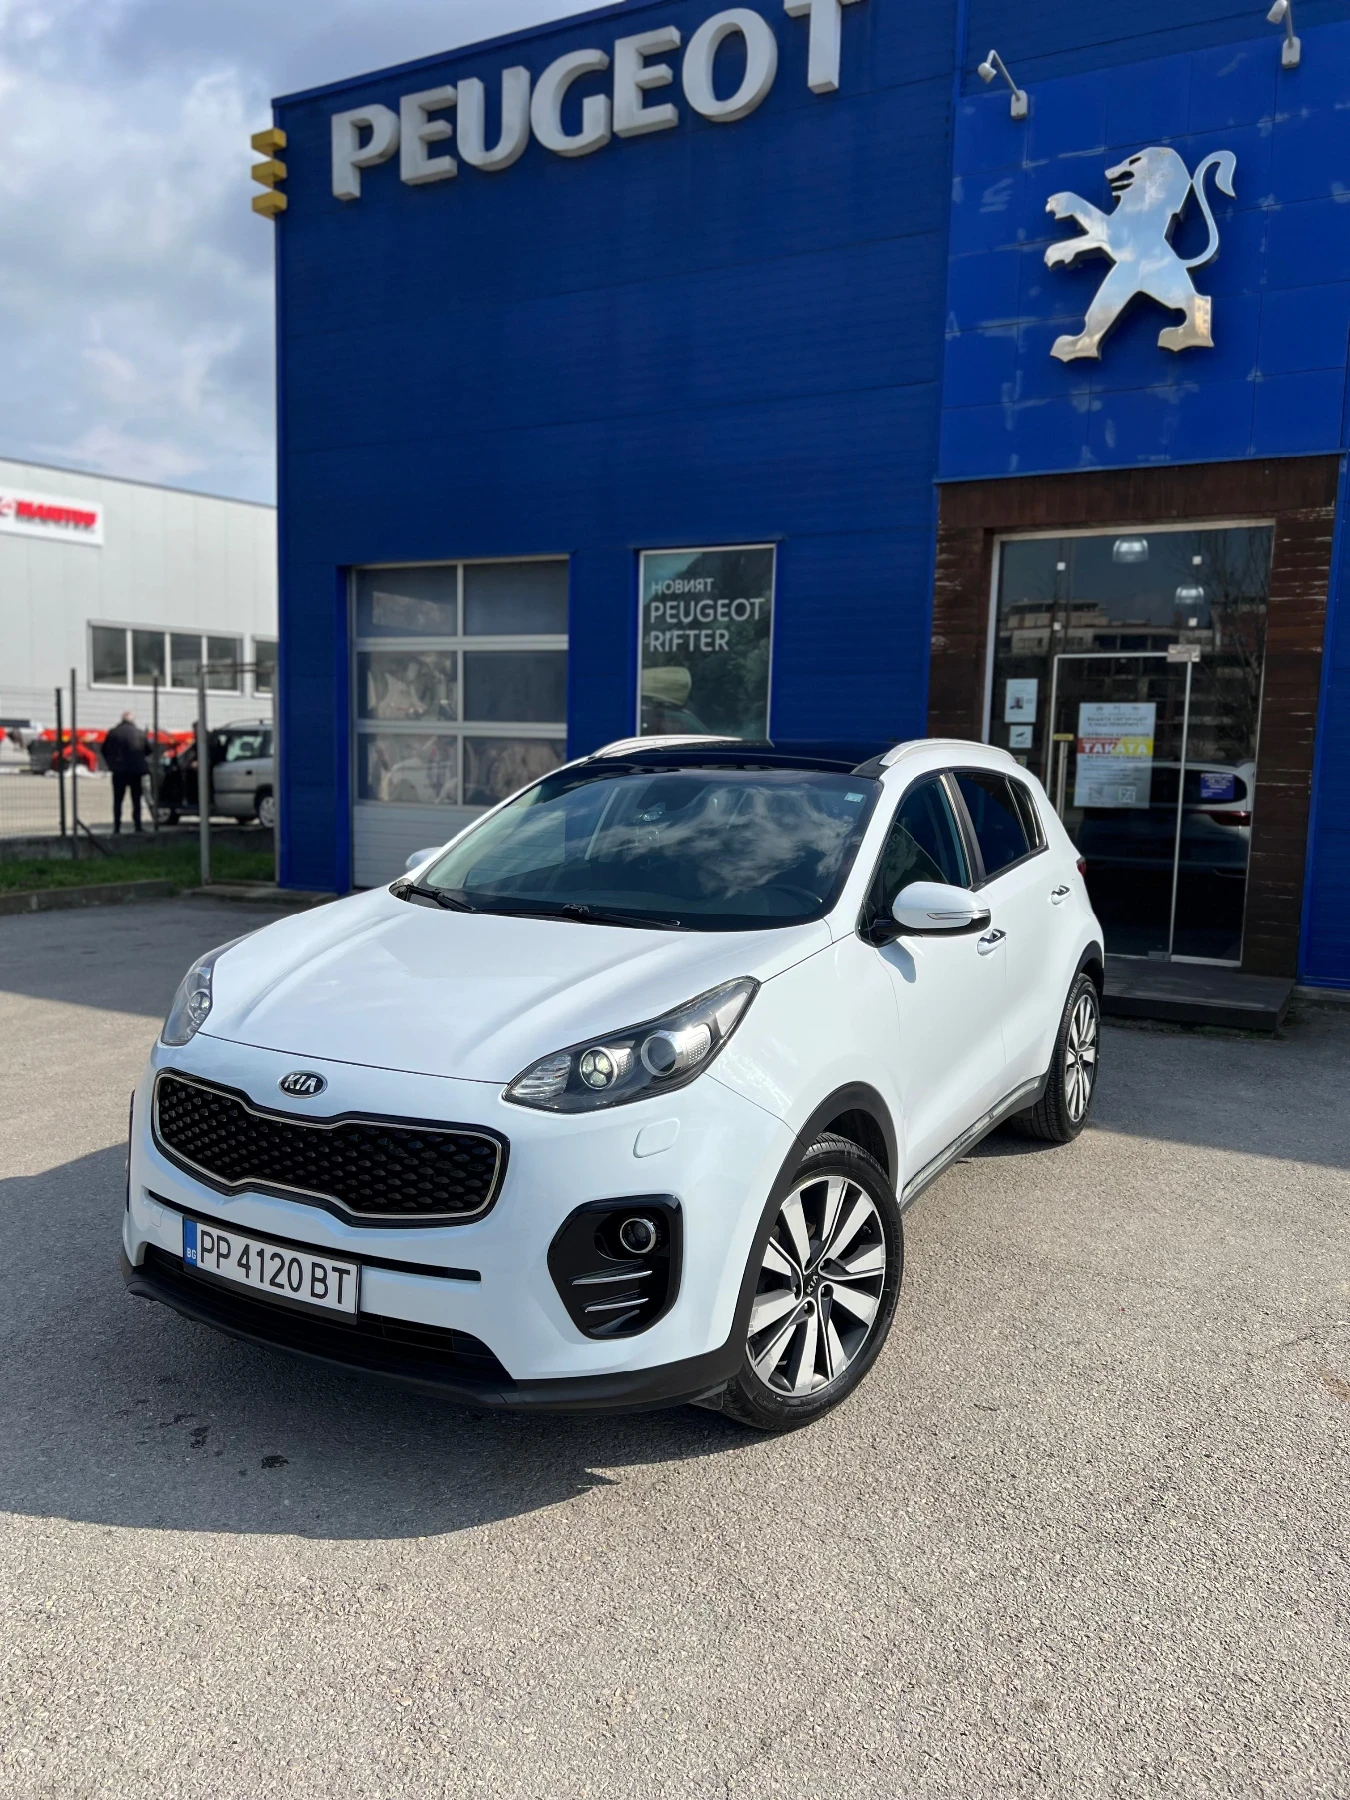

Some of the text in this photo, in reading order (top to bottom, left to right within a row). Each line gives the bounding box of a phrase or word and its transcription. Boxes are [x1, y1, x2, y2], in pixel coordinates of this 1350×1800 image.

[331, 0, 871, 201] PEUGEOT
[652, 578, 714, 595] НОВИЯТ
[650, 598, 765, 624] PEUGEOT
[650, 629, 729, 652] RIFTER
[284, 1074, 318, 1093] KIA
[186, 1247, 197, 1260] BG
[200, 1229, 351, 1305] PP 4120 BT
[806, 1275, 818, 1294] KIA
